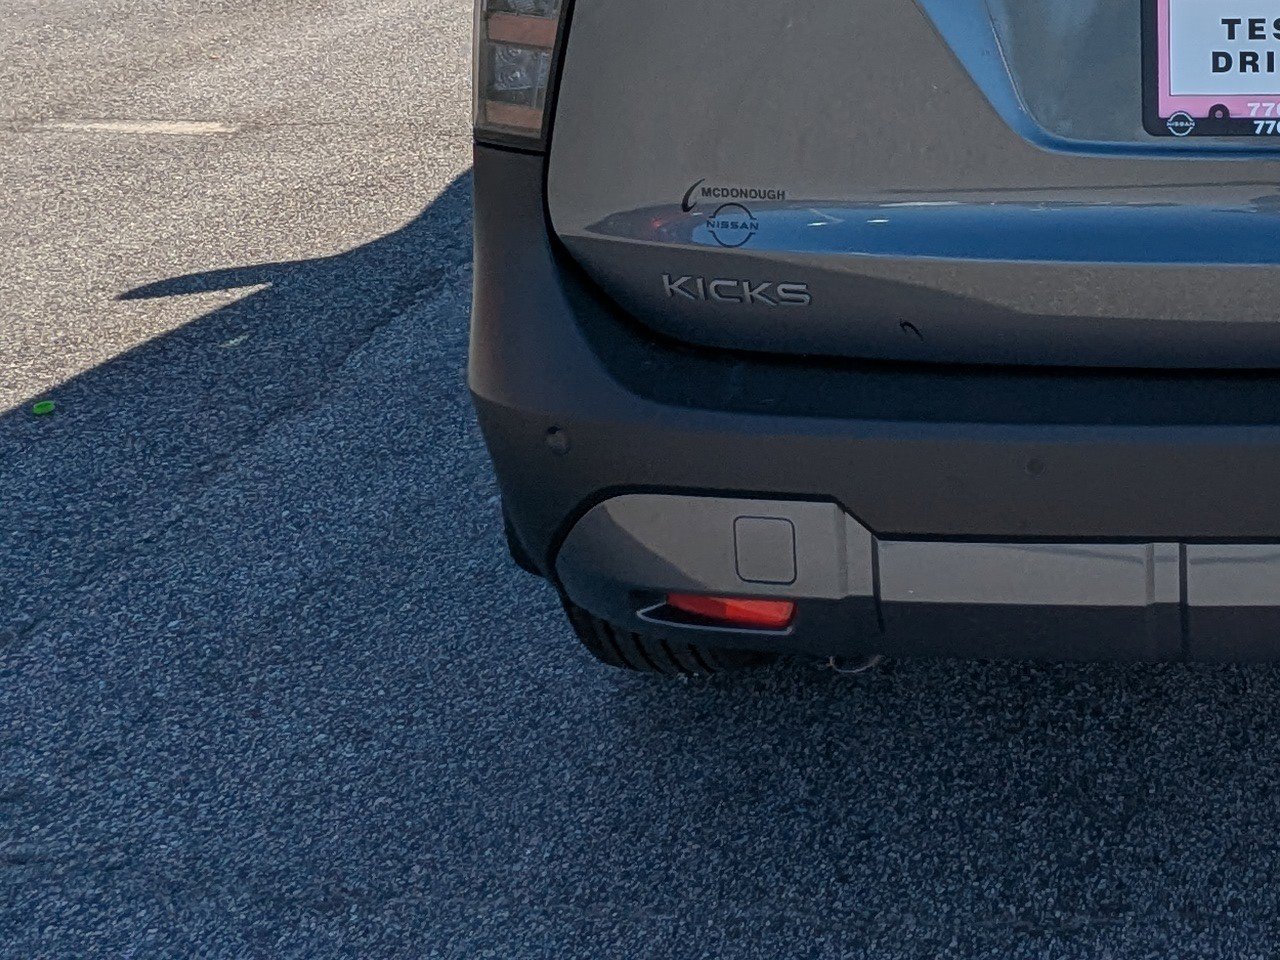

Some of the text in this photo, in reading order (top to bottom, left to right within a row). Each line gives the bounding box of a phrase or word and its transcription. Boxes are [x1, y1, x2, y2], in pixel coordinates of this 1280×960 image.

[701, 187, 786, 200] MCDONOUGH
[706, 220, 759, 231] NISSAN
[661, 272, 812, 307] KICKS
